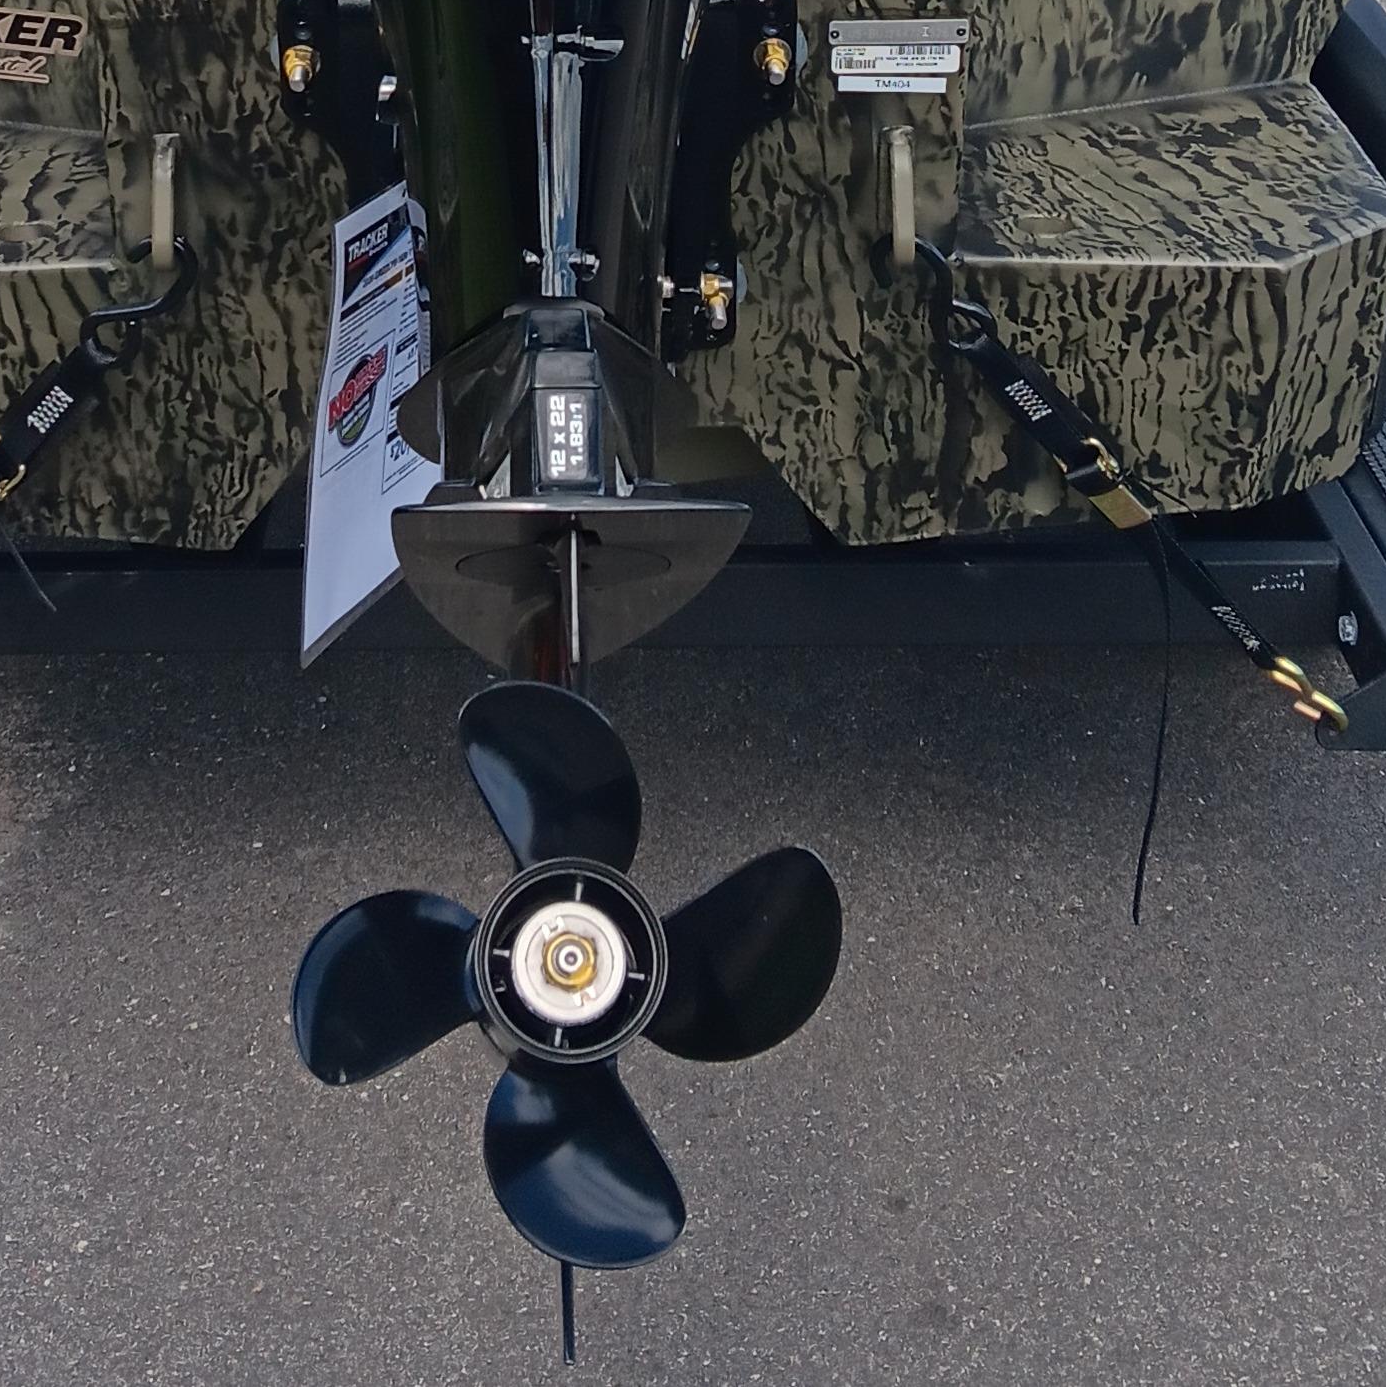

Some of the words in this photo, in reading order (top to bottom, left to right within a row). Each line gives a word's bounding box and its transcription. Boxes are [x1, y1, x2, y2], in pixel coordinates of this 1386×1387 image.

[348, 222, 389, 263] TRACKER
[550, 395, 566, 427] 22
[554, 432, 566, 444] x
[569, 403, 583, 466] 1.83:1
[550, 449, 566, 477] 12
